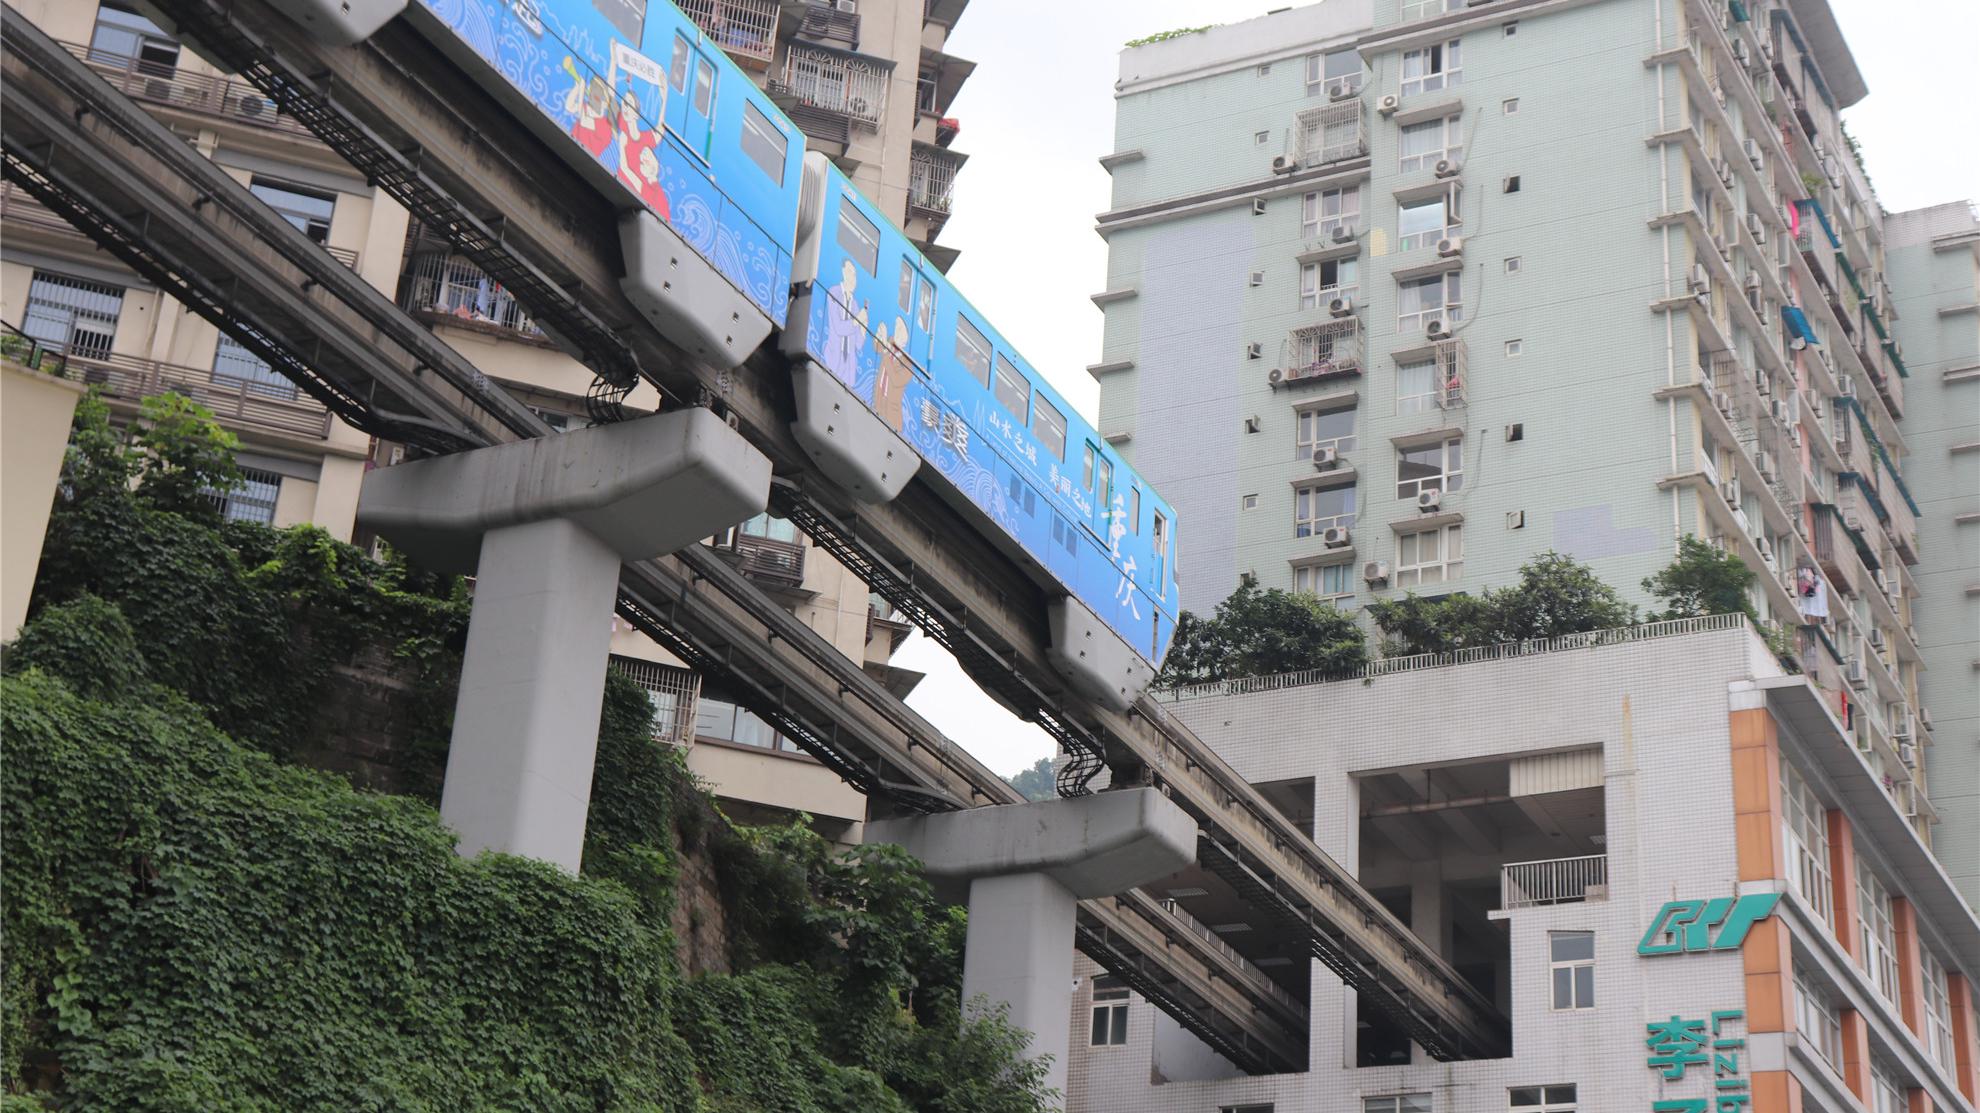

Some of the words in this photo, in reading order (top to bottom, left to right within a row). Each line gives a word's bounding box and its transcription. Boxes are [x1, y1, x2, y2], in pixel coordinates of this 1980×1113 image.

[989, 410, 1037, 466] 山水之城
[1049, 463, 1092, 518] 美丽之地
[1101, 494, 1141, 620] 重庆
[1646, 1015, 1709, 1113] 李
